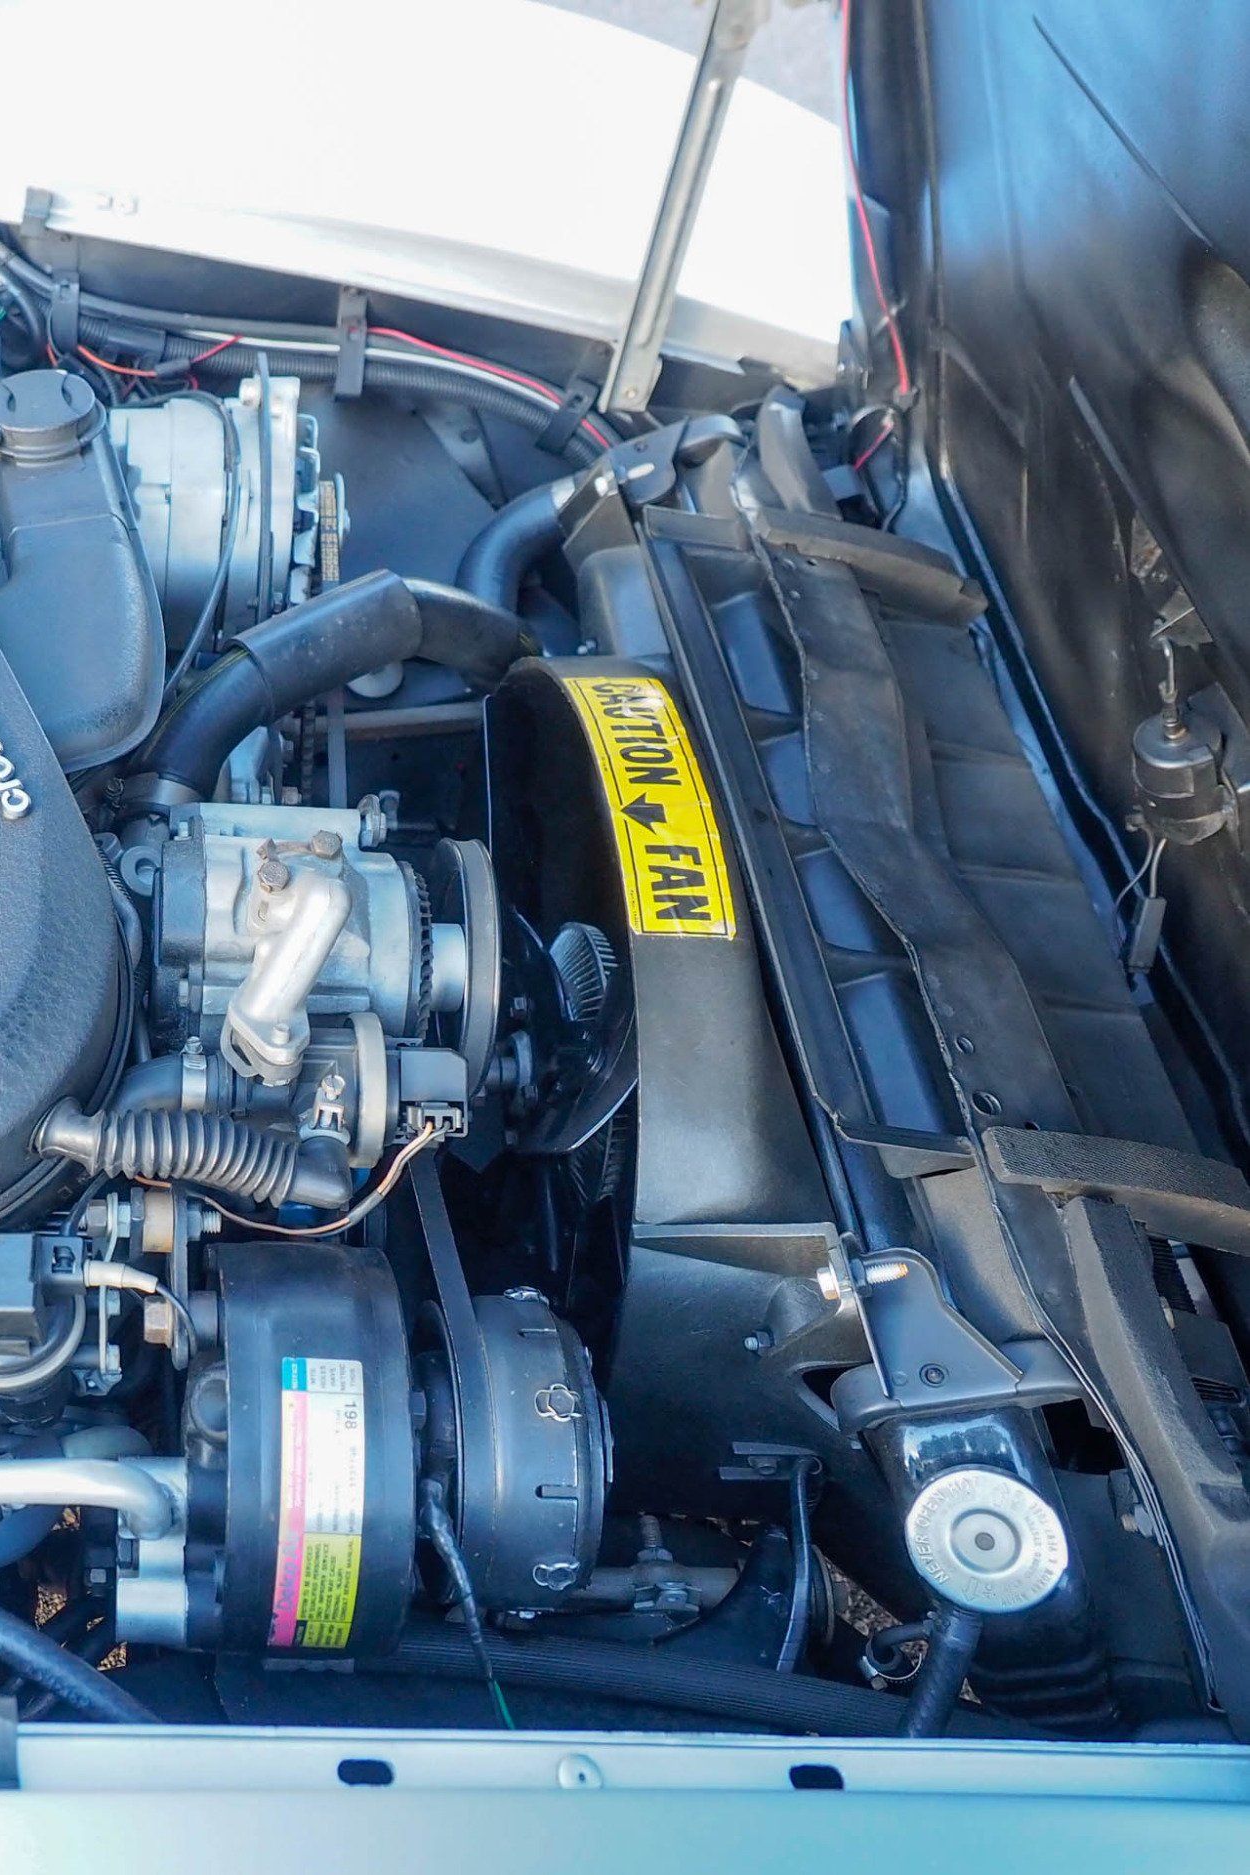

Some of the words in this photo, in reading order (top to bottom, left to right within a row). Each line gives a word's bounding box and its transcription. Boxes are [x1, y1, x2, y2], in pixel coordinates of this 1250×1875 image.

[591, 682, 683, 786] CAUTION
[644, 844, 712, 921] FAN
[915, 1535, 950, 1585] NEVER
